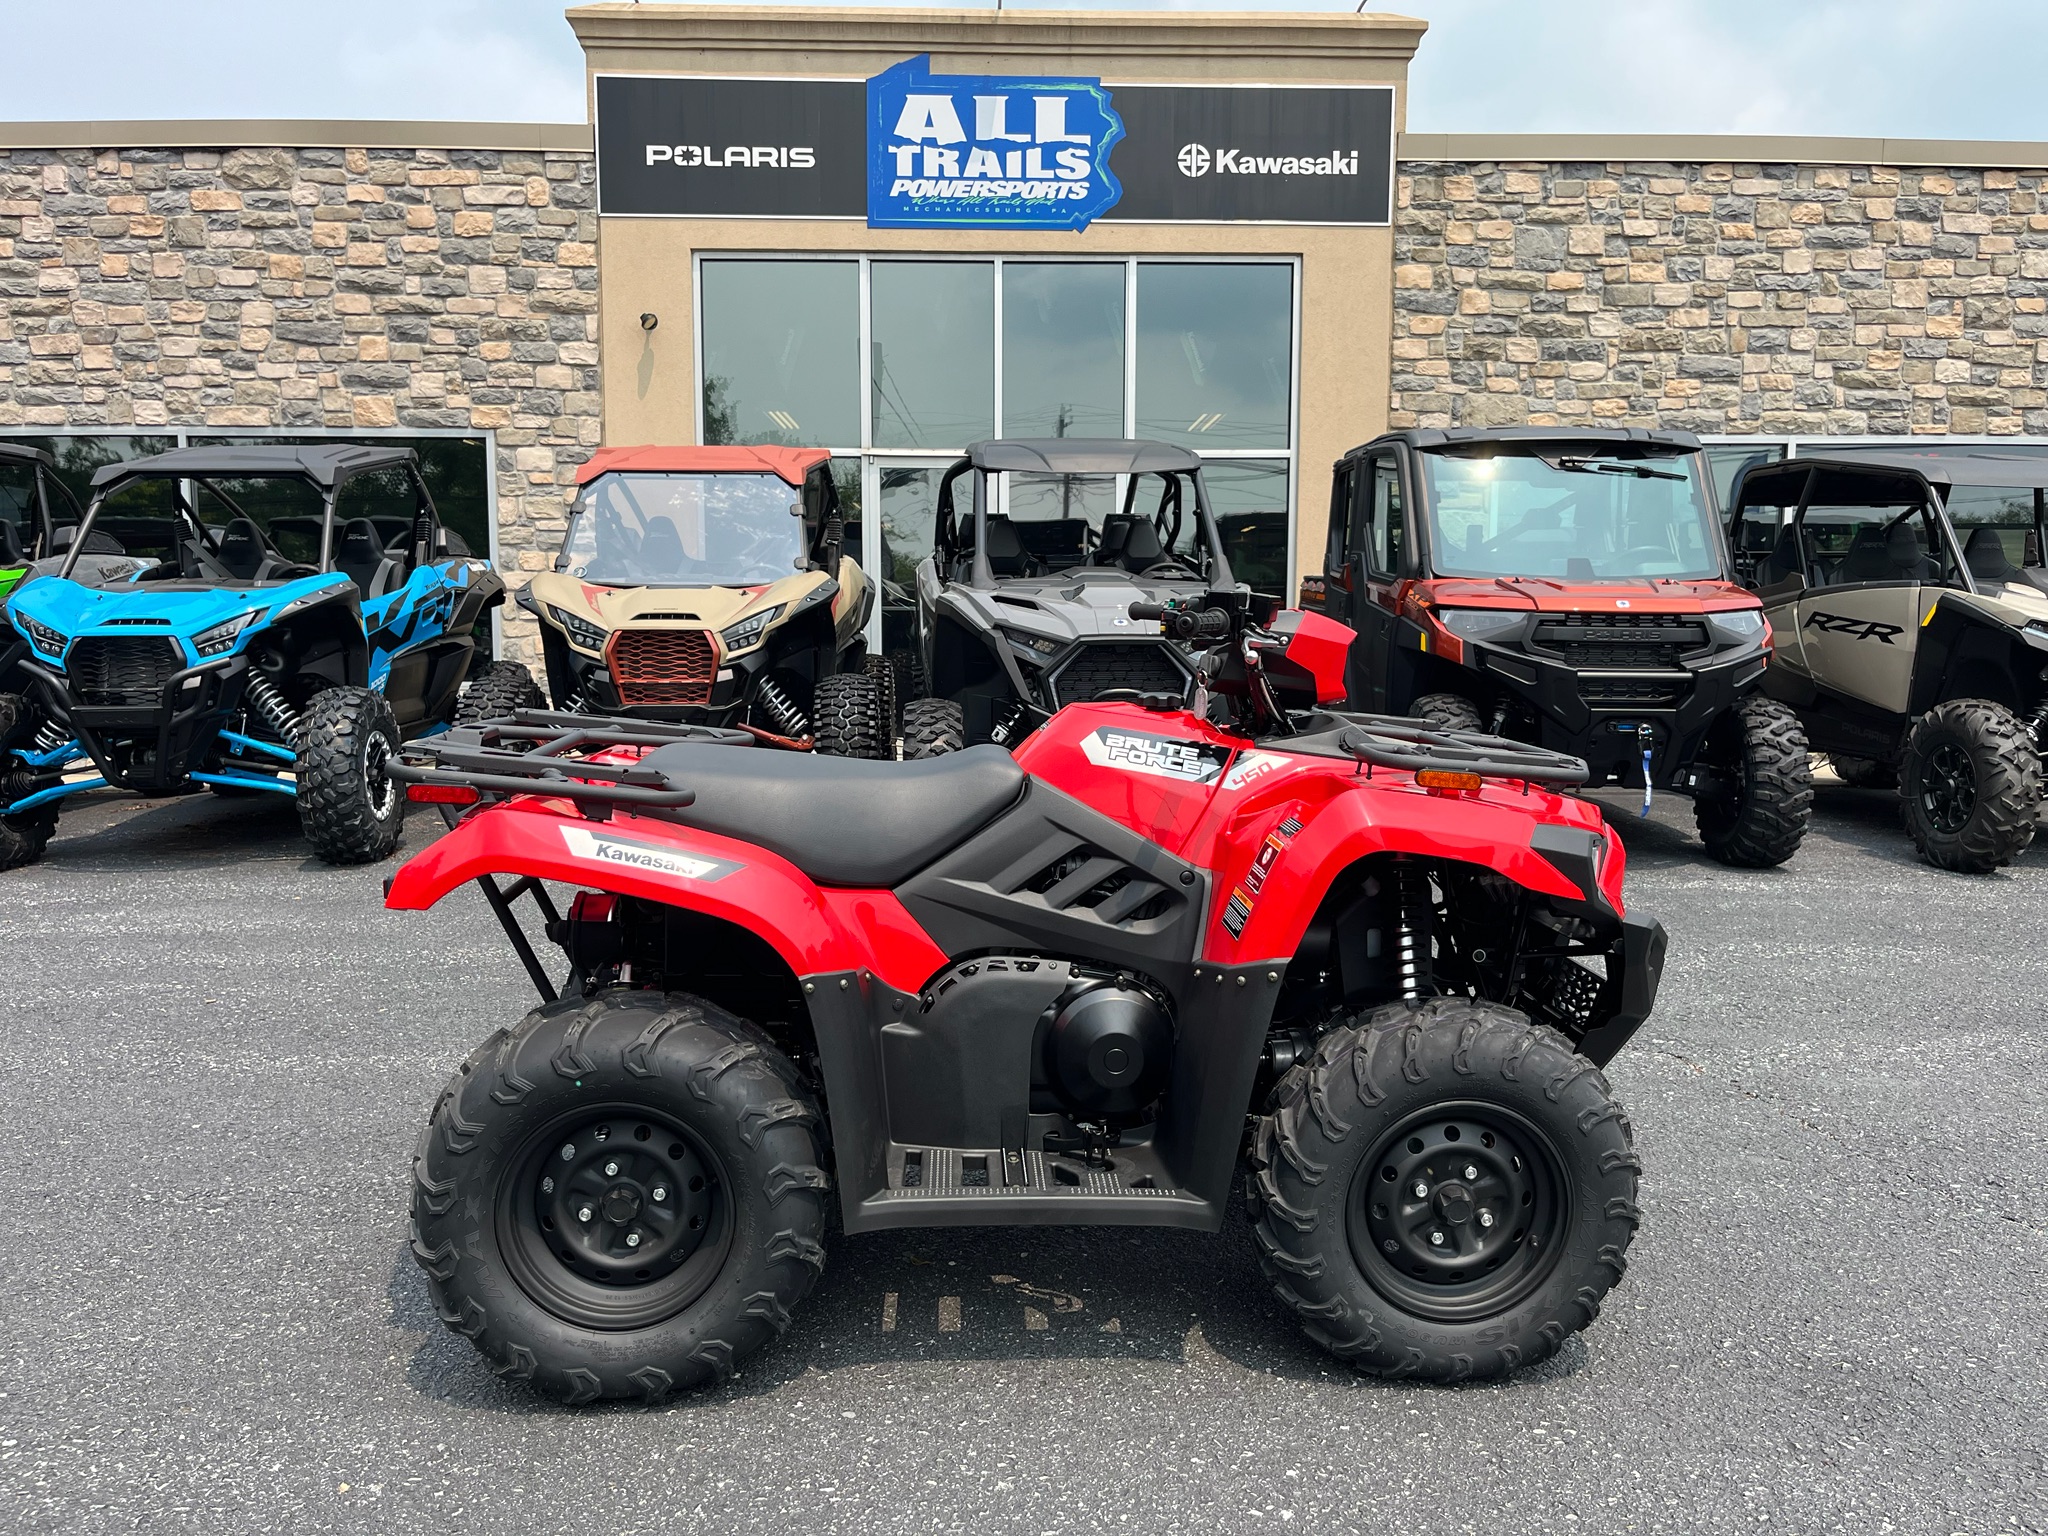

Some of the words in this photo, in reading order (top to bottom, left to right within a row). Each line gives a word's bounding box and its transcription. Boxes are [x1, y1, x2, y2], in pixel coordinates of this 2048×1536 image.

[894, 94, 1091, 146] ALL
[645, 144, 816, 169] POLARIS
[888, 144, 1091, 180] TRAILS
[1216, 149, 1359, 175] Kawasaki
[889, 179, 1090, 200] POWERSPORTS
[1584, 630, 1661, 641] POLARIS
[1803, 610, 1905, 645] RZR
[370, 673, 387, 690] 1000
[1842, 723, 1891, 744] POLARIS
[1106, 733, 1200, 761] BRUTE
[1108, 748, 1204, 775] FORCE
[1231, 761, 1273, 786] 450
